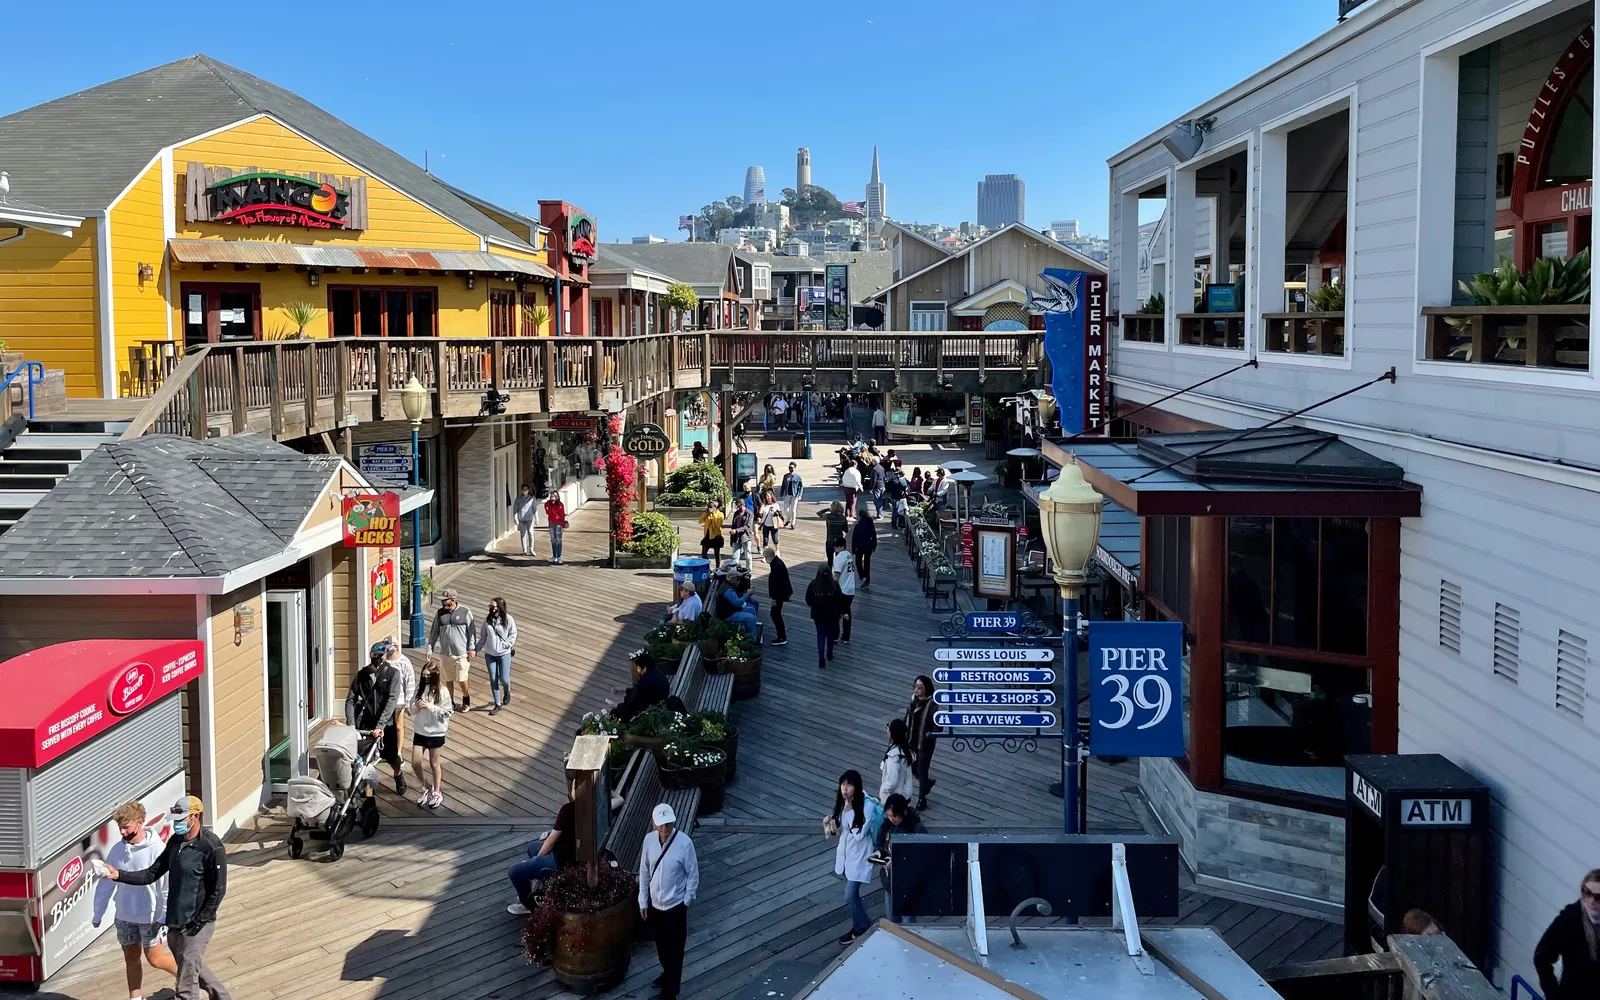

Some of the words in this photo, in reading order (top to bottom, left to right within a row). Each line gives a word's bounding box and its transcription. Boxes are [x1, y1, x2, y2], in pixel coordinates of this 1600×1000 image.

[1517, 66, 1566, 165] PUZZLES
[236, 214, 255, 226] The
[256, 210, 283, 226] Flavor
[285, 214, 297, 224] of
[298, 214, 331, 229] Mexico
[1090, 281, 1102, 336] PIER
[1088, 345, 1102, 428] MARKET
[628, 440, 665, 452] GOLD
[369, 517, 397, 530] HOT
[355, 531, 395, 544] LICKS
[382, 582, 393, 599] HOT
[377, 596, 393, 617] LICKS
[973, 617, 1001, 627] PIER
[1003, 616, 1016, 628] 39
[163, 660, 177, 673] COFFEE
[178, 650, 196, 665] ESPRESSO
[956, 650, 990, 660] SWISS
[993, 650, 1027, 660] LOUIS
[1100, 647, 1169, 671] PIER
[161, 673, 171, 683] ICED
[171, 665, 185, 679] COFFEE
[184, 659, 197, 672] DRINKS
[960, 671, 1030, 681] RESTROOMS
[122, 673, 145, 702] Biscoff
[954, 693, 988, 703] LEVEL
[991, 693, 998, 703] 2
[1000, 693, 1039, 703] SHOPS
[124, 699, 136, 709] COFFEE
[1098, 674, 1173, 730] 39
[41, 733, 61, 750] SERVED
[60, 726, 73, 741] WITH
[72, 719, 87, 734] EVERY
[86, 710, 103, 726] COFFEE
[48, 722, 61, 736] FREE
[60, 711, 80, 729] BISCOFF
[79, 703, 96, 719] COOKIE
[962, 715, 983, 725] BAY
[986, 715, 1022, 725] VIEWS
[1356, 776, 1380, 814] ATM
[1407, 800, 1462, 822] ATM
[61, 862, 81, 886] Lotus
[50, 868, 96, 932] Biscoff
